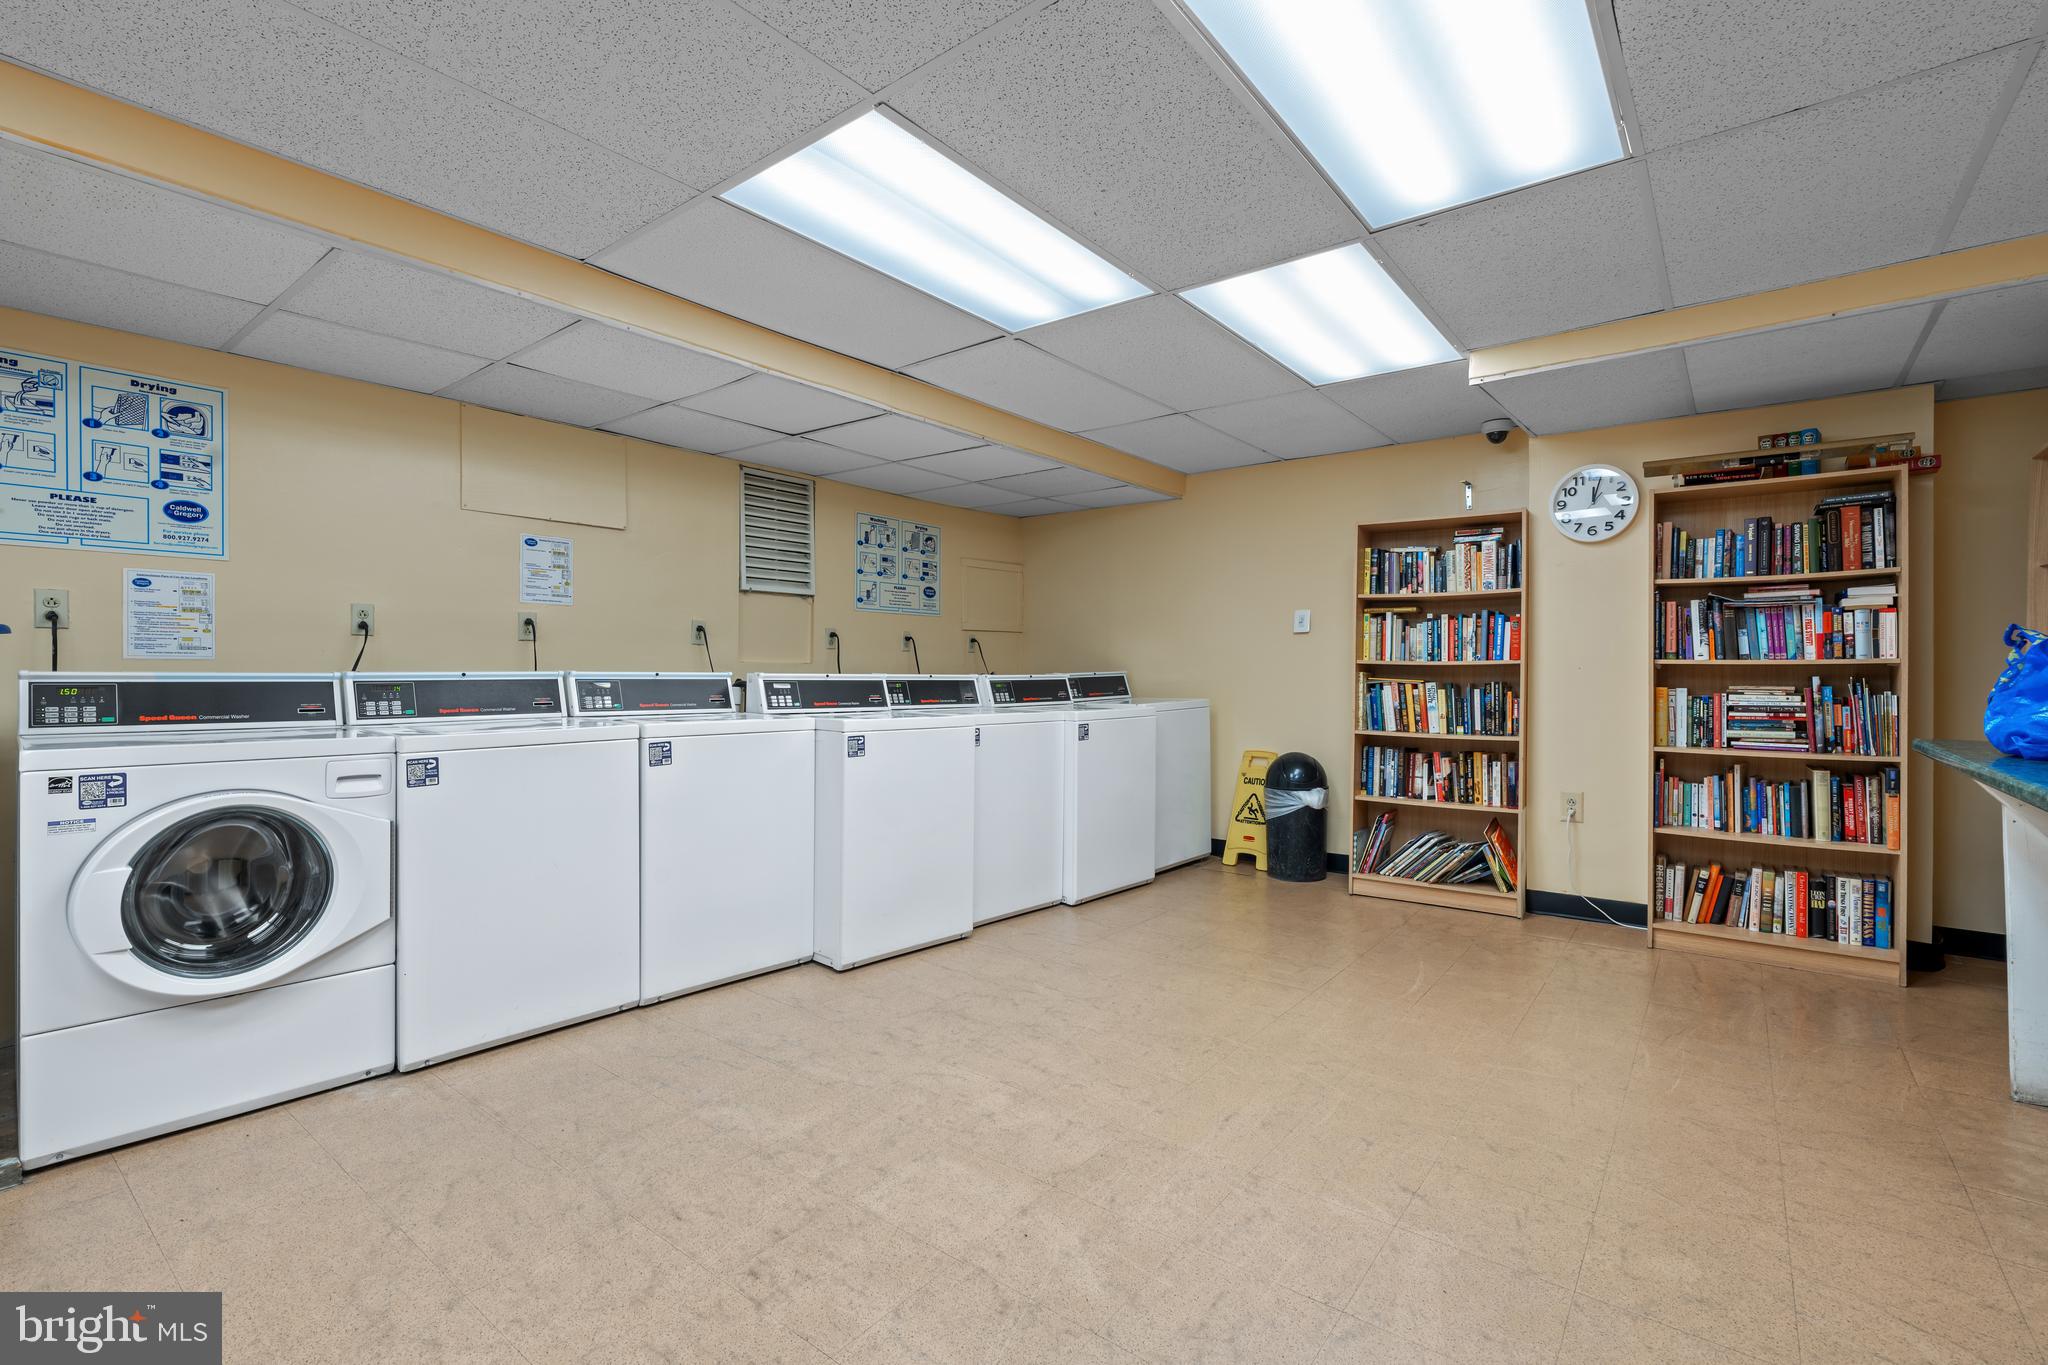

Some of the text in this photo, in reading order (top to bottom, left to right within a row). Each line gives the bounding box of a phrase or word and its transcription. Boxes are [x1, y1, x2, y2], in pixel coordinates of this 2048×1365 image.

[130, 380, 176, 394] Drying
[1573, 476, 1584, 486] 11
[1616, 482, 1626, 491] 2
[1562, 487, 1577, 497] 10
[50, 493, 97, 503] PLEASE
[1557, 500, 1566, 510] 9
[174, 511, 203, 519] Gregory
[1614, 510, 1625, 519] 4
[1574, 523, 1582, 532] 7
[1587, 526, 1597, 536] 6
[1604, 522, 1614, 531] 5
[1244, 776, 1265, 786] CAUTIO
[1864, 919, 1874, 938] PASS
